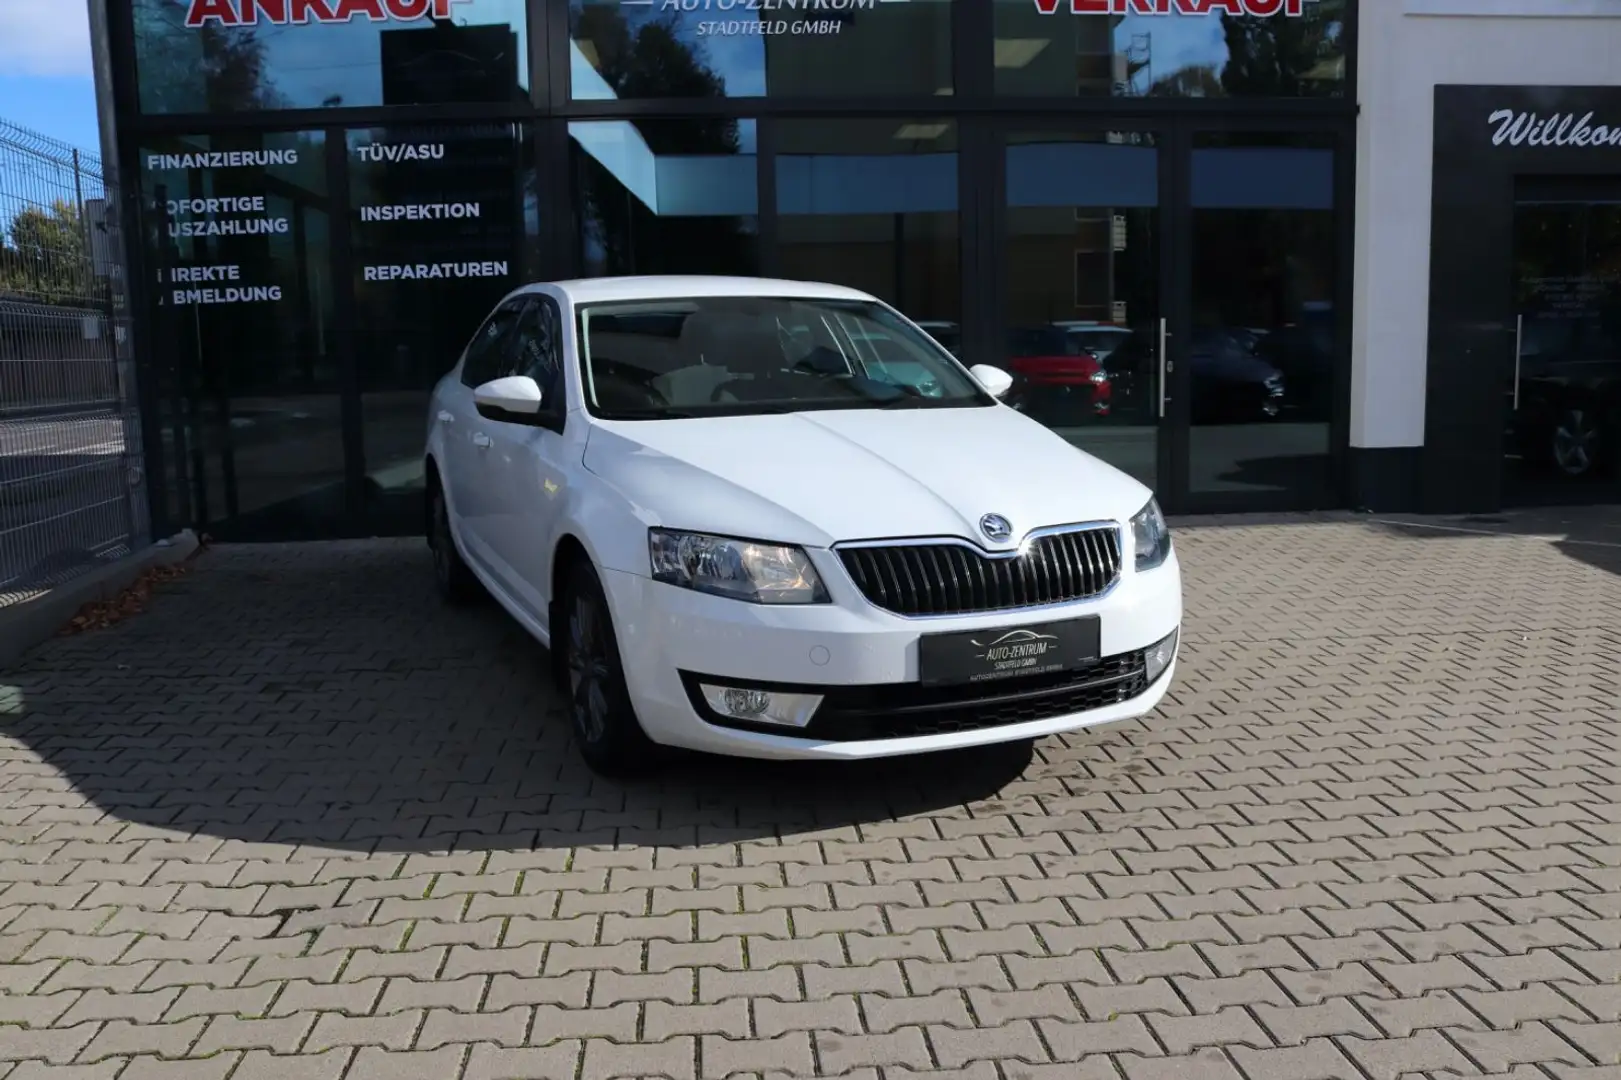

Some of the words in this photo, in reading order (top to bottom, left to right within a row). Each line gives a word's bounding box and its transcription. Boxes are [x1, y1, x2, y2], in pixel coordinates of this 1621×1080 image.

[697, 20, 788, 36] STADTFELD
[791, 20, 842, 35] GMBH
[147, 149, 299, 170] FINANZIERUNG
[357, 142, 445, 163] TÜV/ASU
[152, 196, 265, 215] OFORTIGE
[360, 202, 480, 222] INSPEKTION
[154, 217, 289, 238] USZAHLUNG
[363, 261, 509, 281] REPARATUREN
[158, 285, 283, 306] BMELDUNG
[986, 642, 1048, 661] AUTO-ZENTRUM
